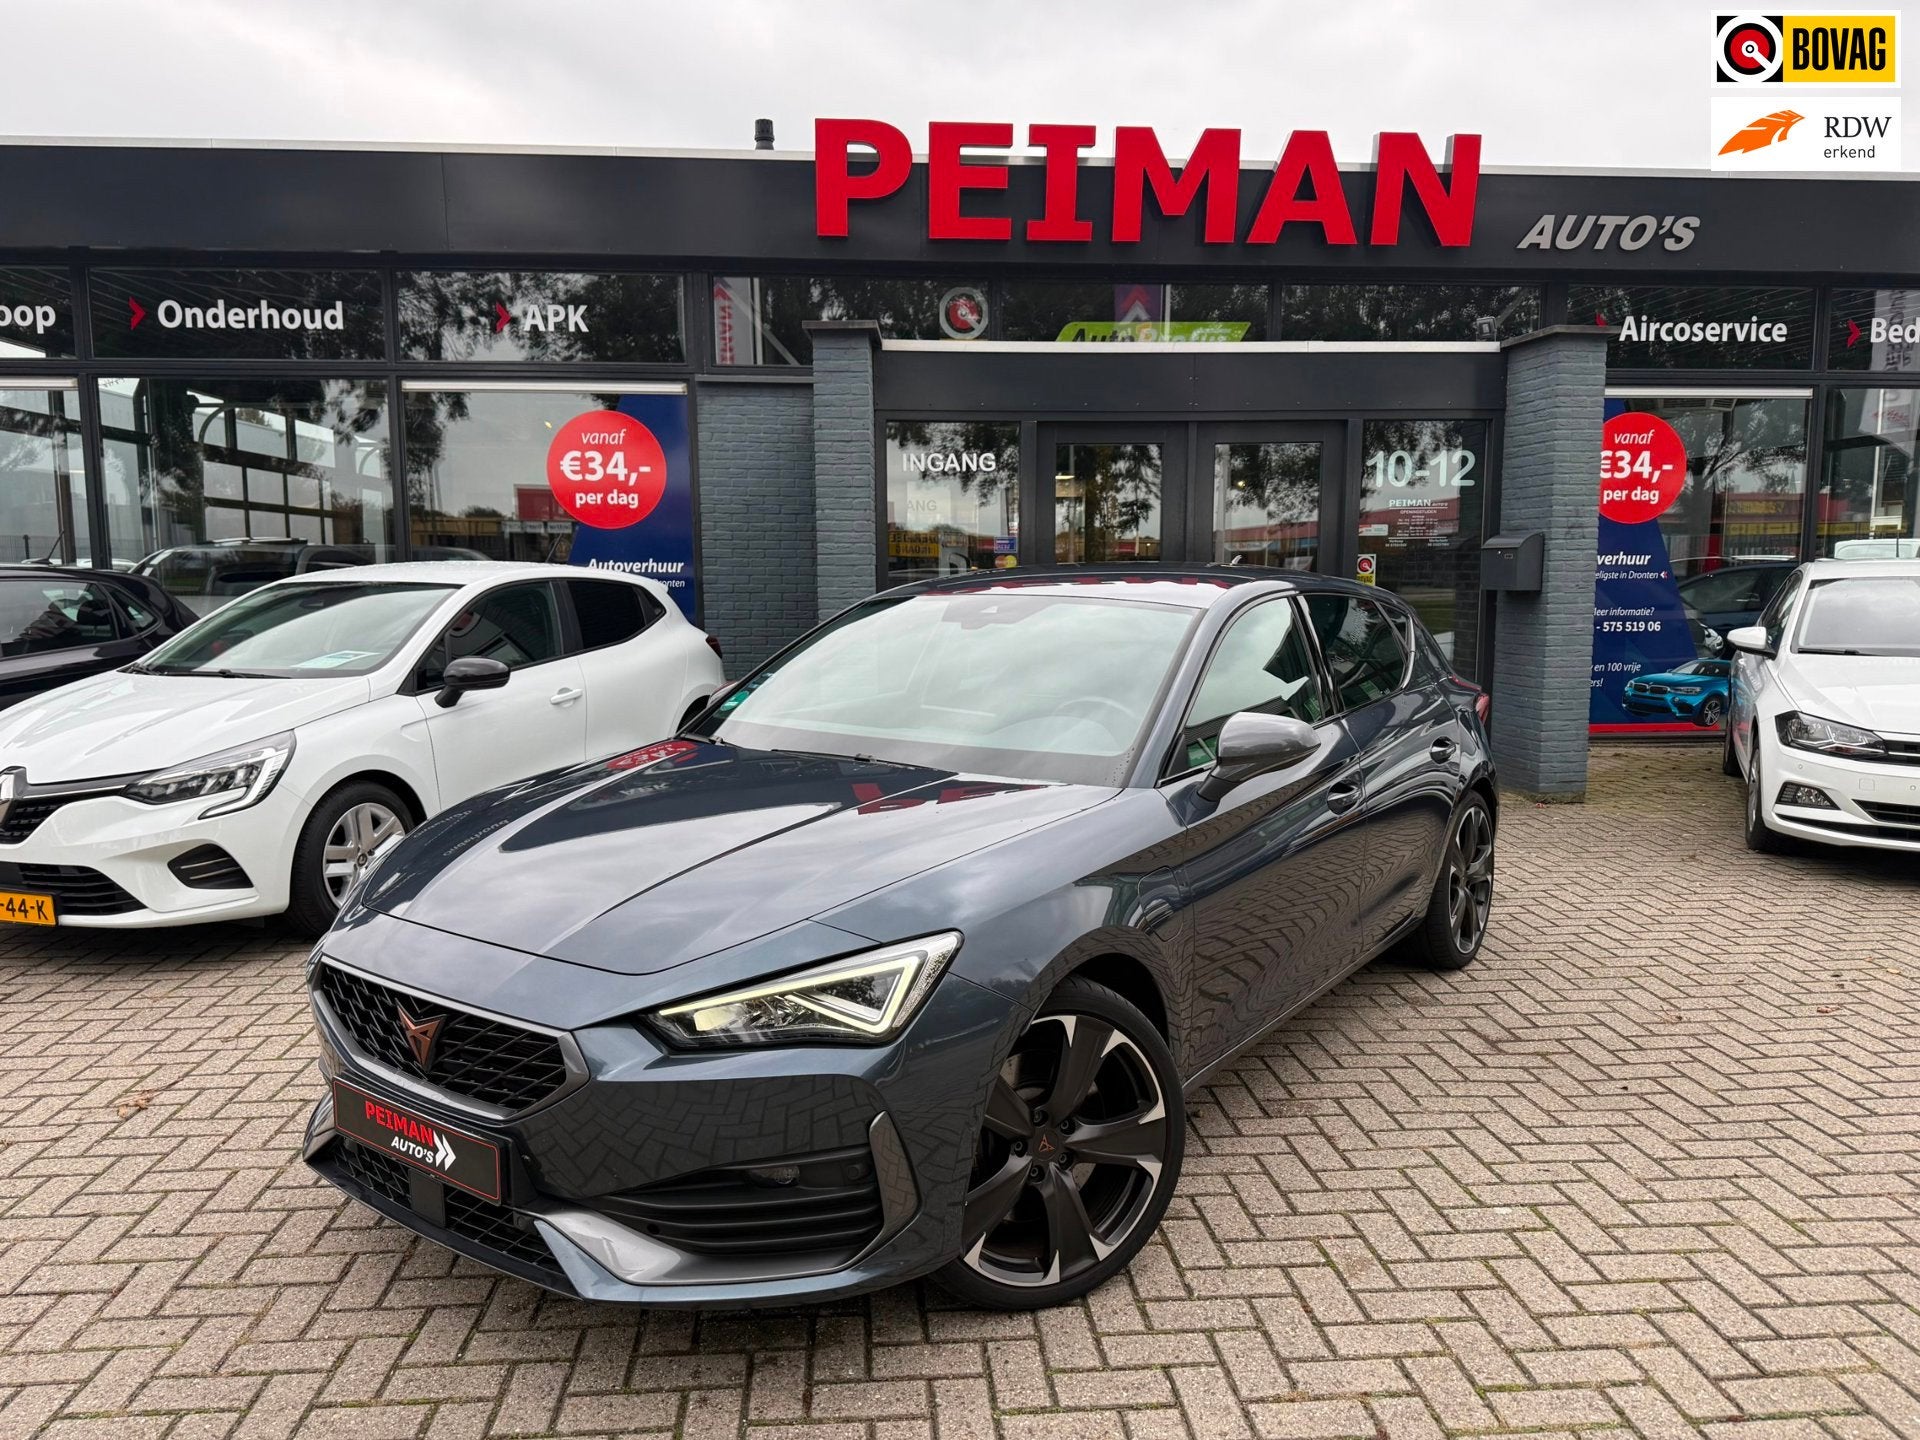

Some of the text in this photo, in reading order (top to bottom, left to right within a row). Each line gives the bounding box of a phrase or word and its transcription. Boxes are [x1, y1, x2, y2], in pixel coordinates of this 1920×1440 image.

[815, 118, 1701, 252] PEIMAN AUTO'S
[0, 304, 56, 334] oop
[157, 299, 344, 330] Onderhoud
[523, 304, 589, 332] APK
[1618, 315, 1788, 343] Aircoservice
[1870, 317, 1920, 343] Bed
[581, 428, 627, 445] vanaf
[1613, 429, 1656, 445] vanaf
[559, 450, 652, 487] €34,-
[902, 452, 997, 472] INGANG
[1365, 449, 1476, 488] 10-12
[575, 488, 639, 509] per dag
[1389, 499, 1431, 507] PEIMAN
[1603, 486, 1660, 505] per dag
[587, 558, 685, 573] Autoverhuur
[1597, 551, 1652, 566] verhuur
[1620, 571, 1627, 579] in
[1628, 570, 1659, 580] Dronten
[1609, 607, 1656, 616] informatie?
[1602, 621, 1623, 632] 575
[1625, 621, 1646, 632] 519
[1647, 621, 1662, 632] 06
[1594, 662, 1642, 674] en 100 vrije
[365, 1101, 434, 1148] PEIMAN
[391, 1136, 434, 1164] AUTO'S
